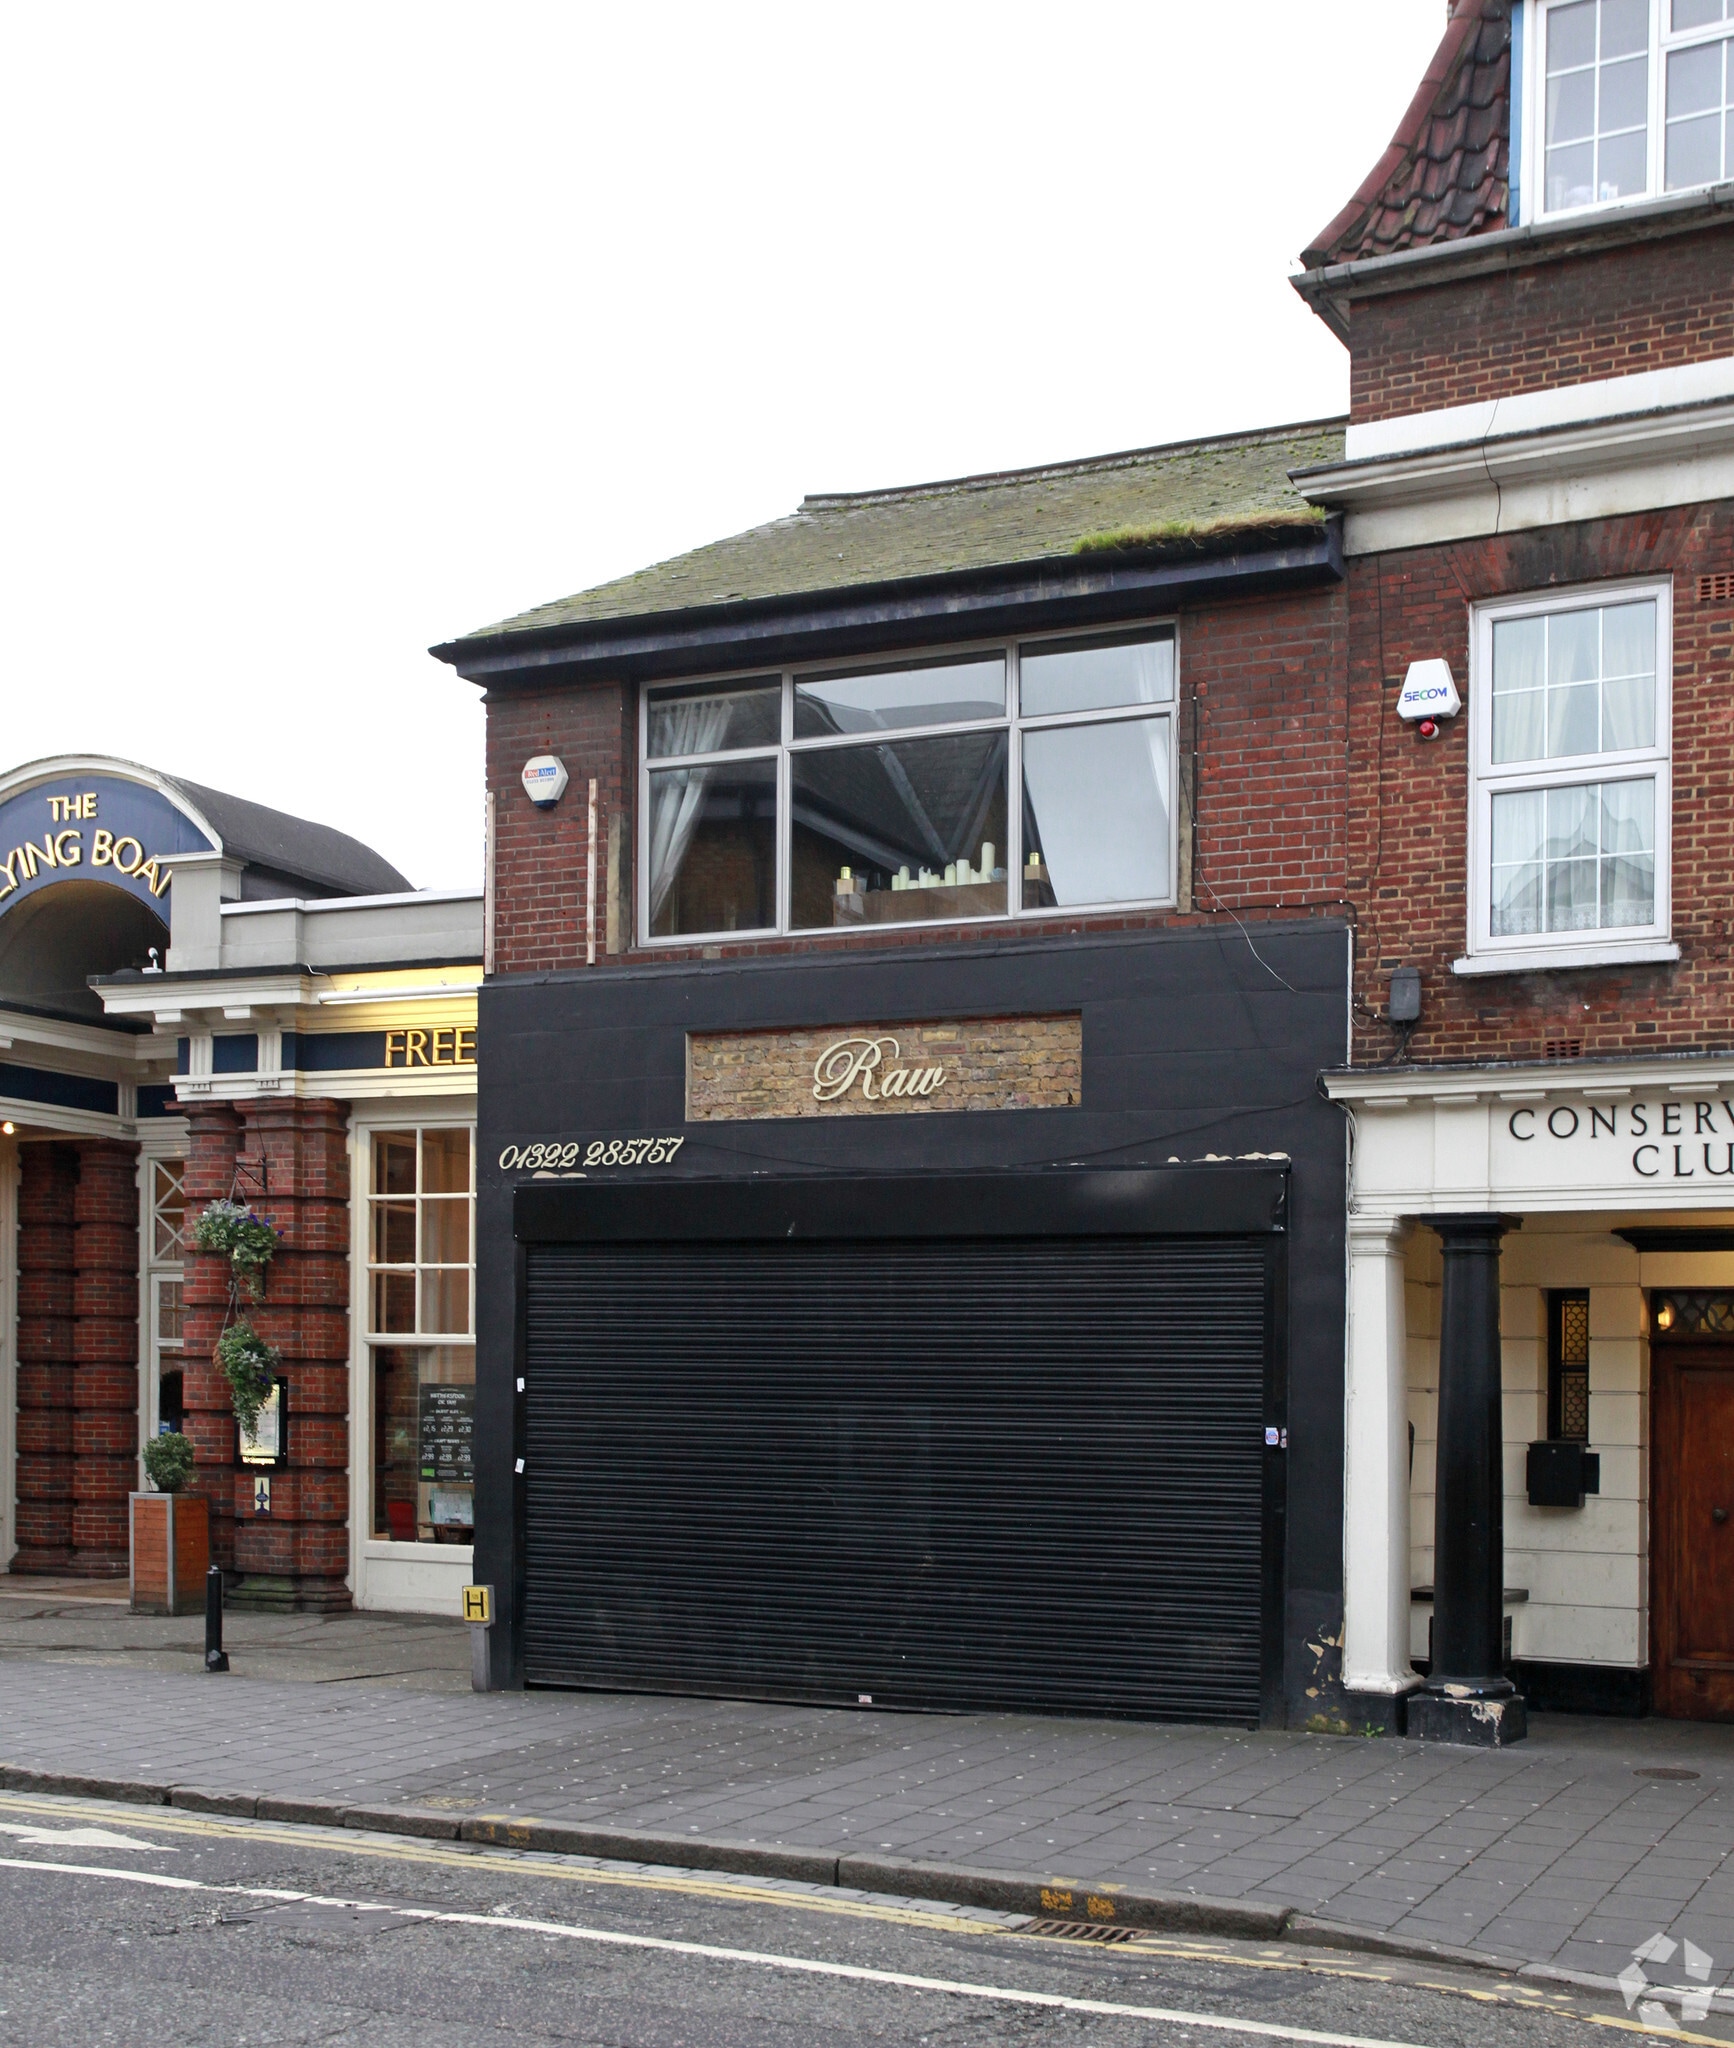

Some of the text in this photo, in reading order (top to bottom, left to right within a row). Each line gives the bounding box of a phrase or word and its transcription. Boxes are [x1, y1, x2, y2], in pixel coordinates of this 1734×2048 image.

[1404, 687, 1448, 702] SECOM
[47, 792, 98, 822] THE
[0, 829, 83, 901] YING
[385, 1026, 476, 1068] FREE
[813, 1037, 947, 1101] Raw
[499, 1136, 684, 1170] 01322 285757
[467, 1591, 485, 1618] H
